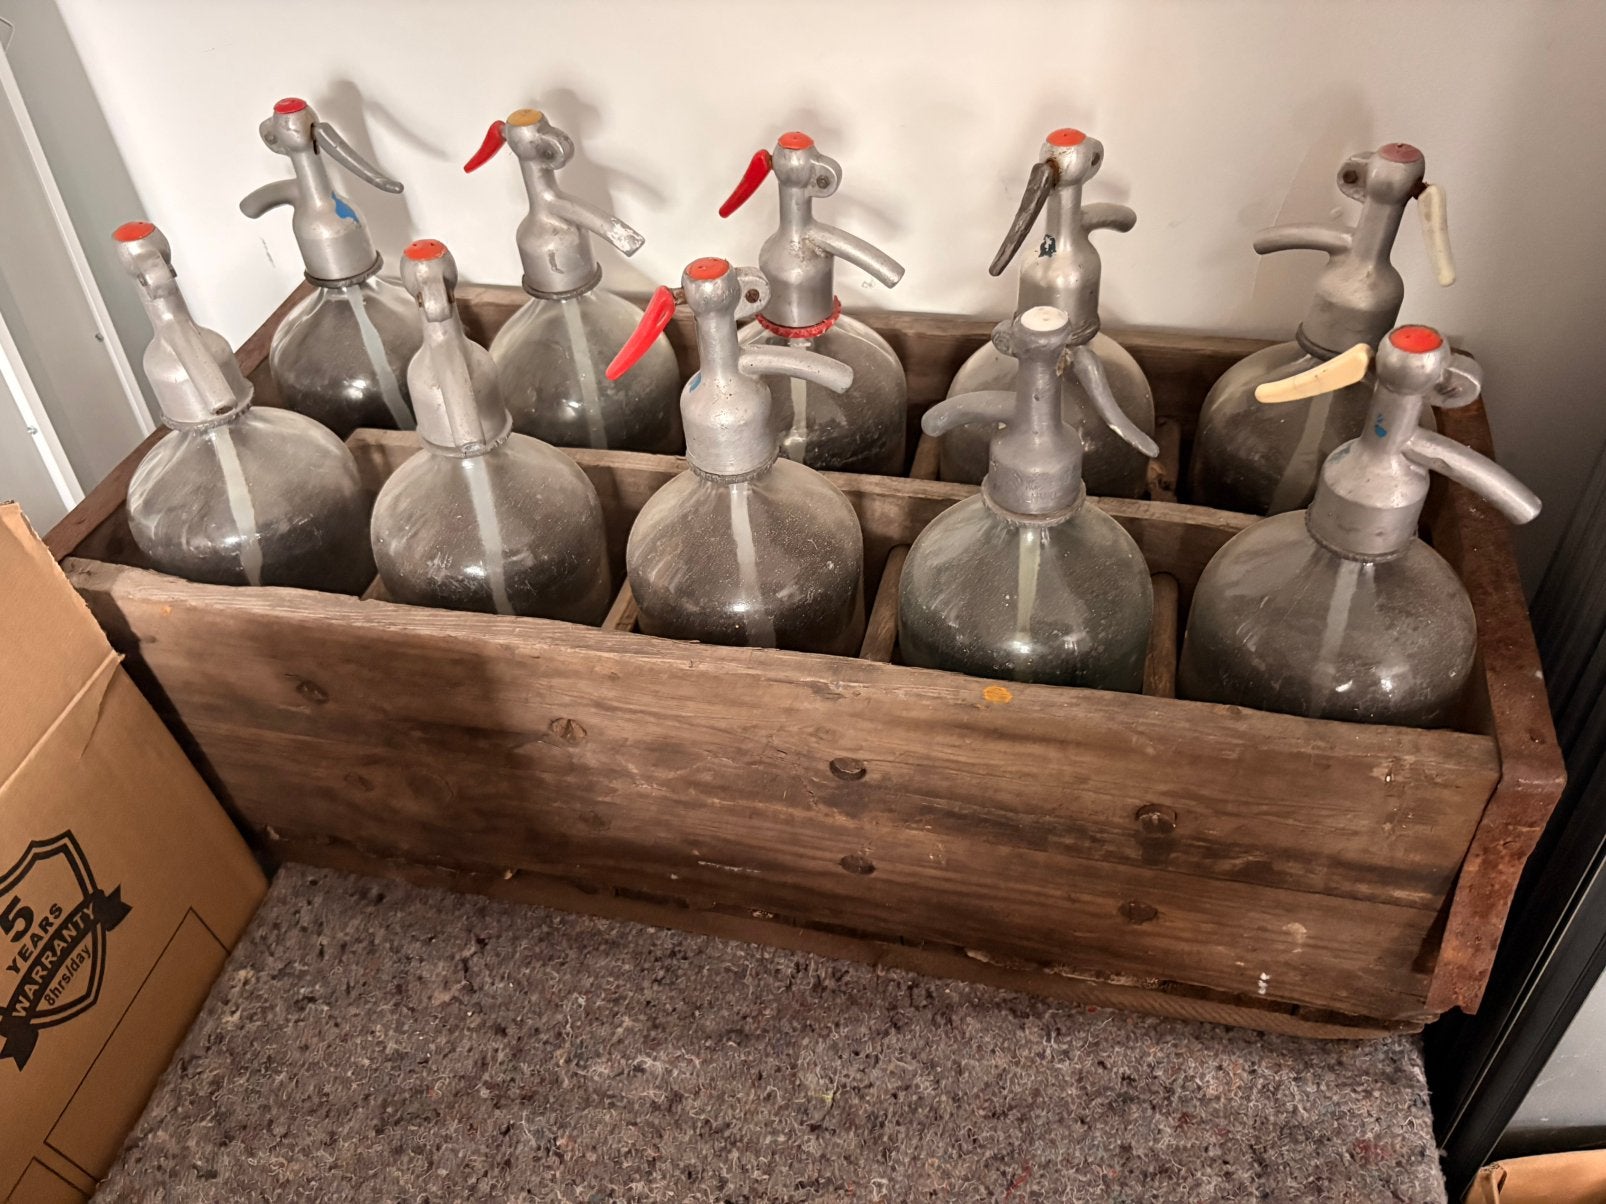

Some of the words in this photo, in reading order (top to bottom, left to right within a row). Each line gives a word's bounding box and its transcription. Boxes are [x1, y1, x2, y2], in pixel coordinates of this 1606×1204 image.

[0, 895, 34, 943] 5
[6, 903, 63, 975] YEARS
[12, 902, 94, 1017] WARRANTY
[44, 944, 92, 1006] 8hrs/day
